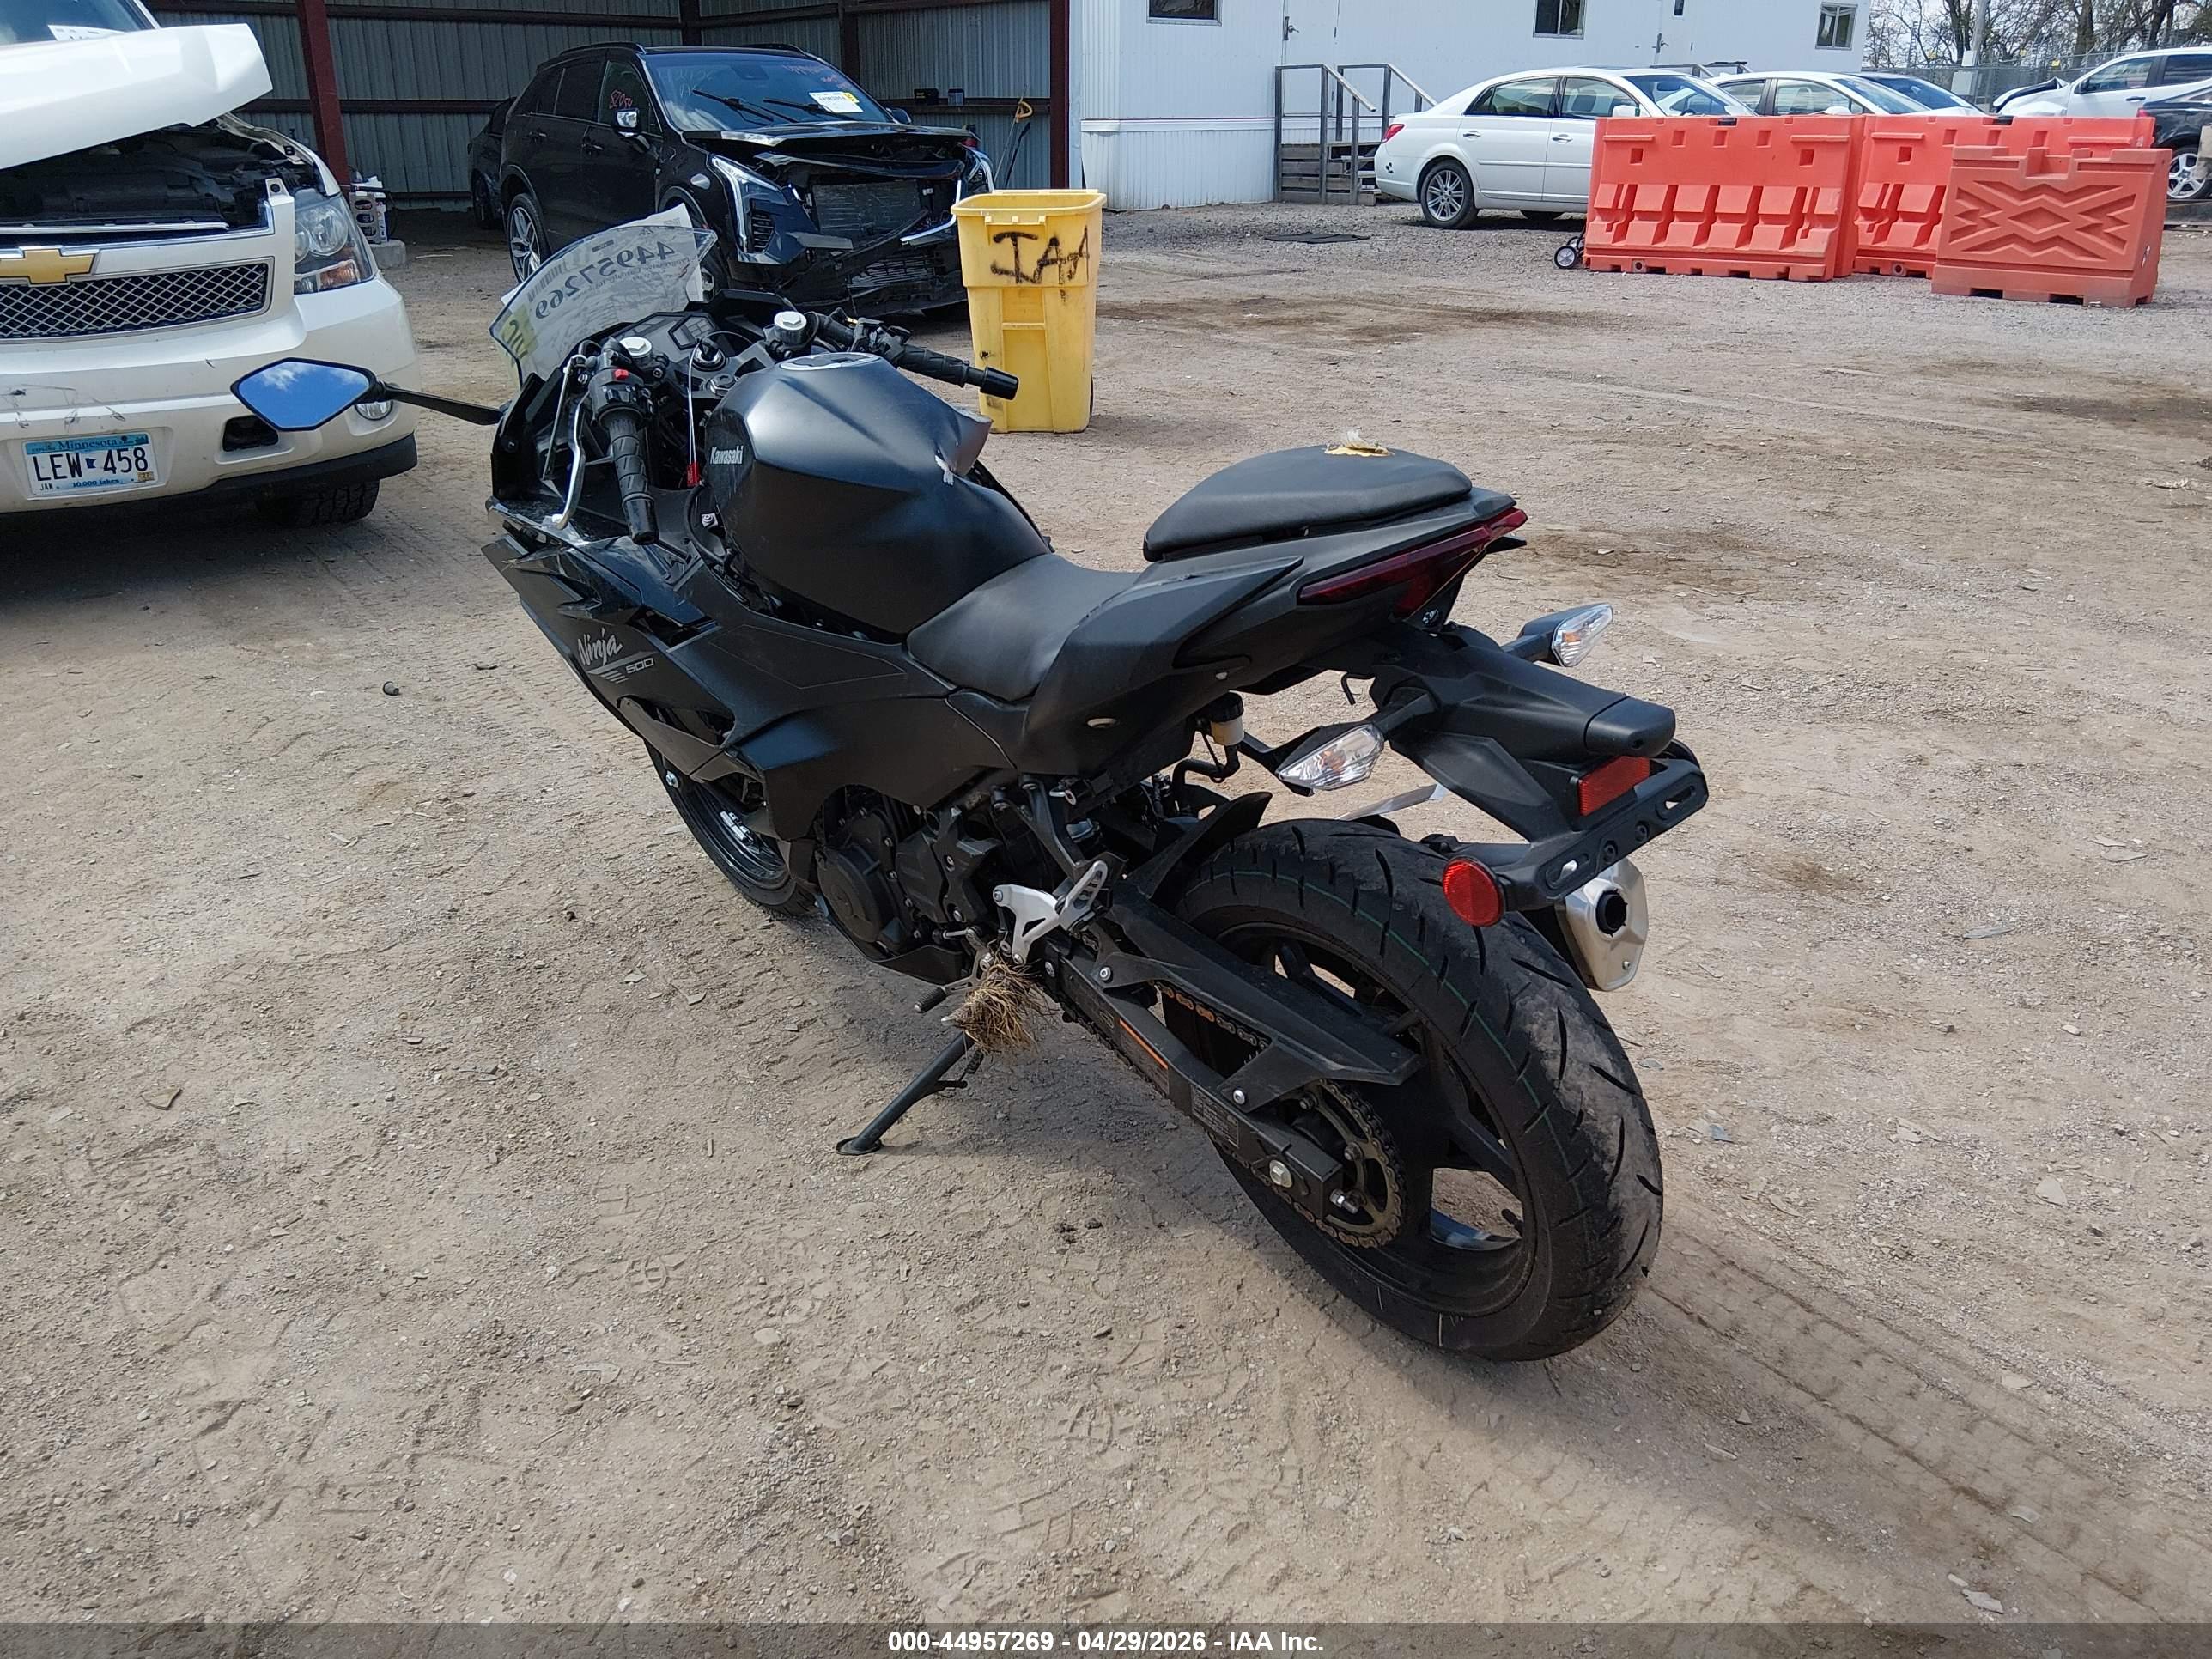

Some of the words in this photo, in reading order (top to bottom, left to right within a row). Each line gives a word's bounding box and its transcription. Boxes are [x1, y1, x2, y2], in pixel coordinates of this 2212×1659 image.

[990, 225, 1090, 284] IAA
[58, 438, 118, 451] Minnesota
[33, 452, 82, 482] LEW
[102, 447, 149, 475] 458
[709, 445, 744, 465] Kawasaki
[40, 482, 54, 491] JAN
[577, 627, 623, 666] Ninja
[625, 657, 654, 674] 500
